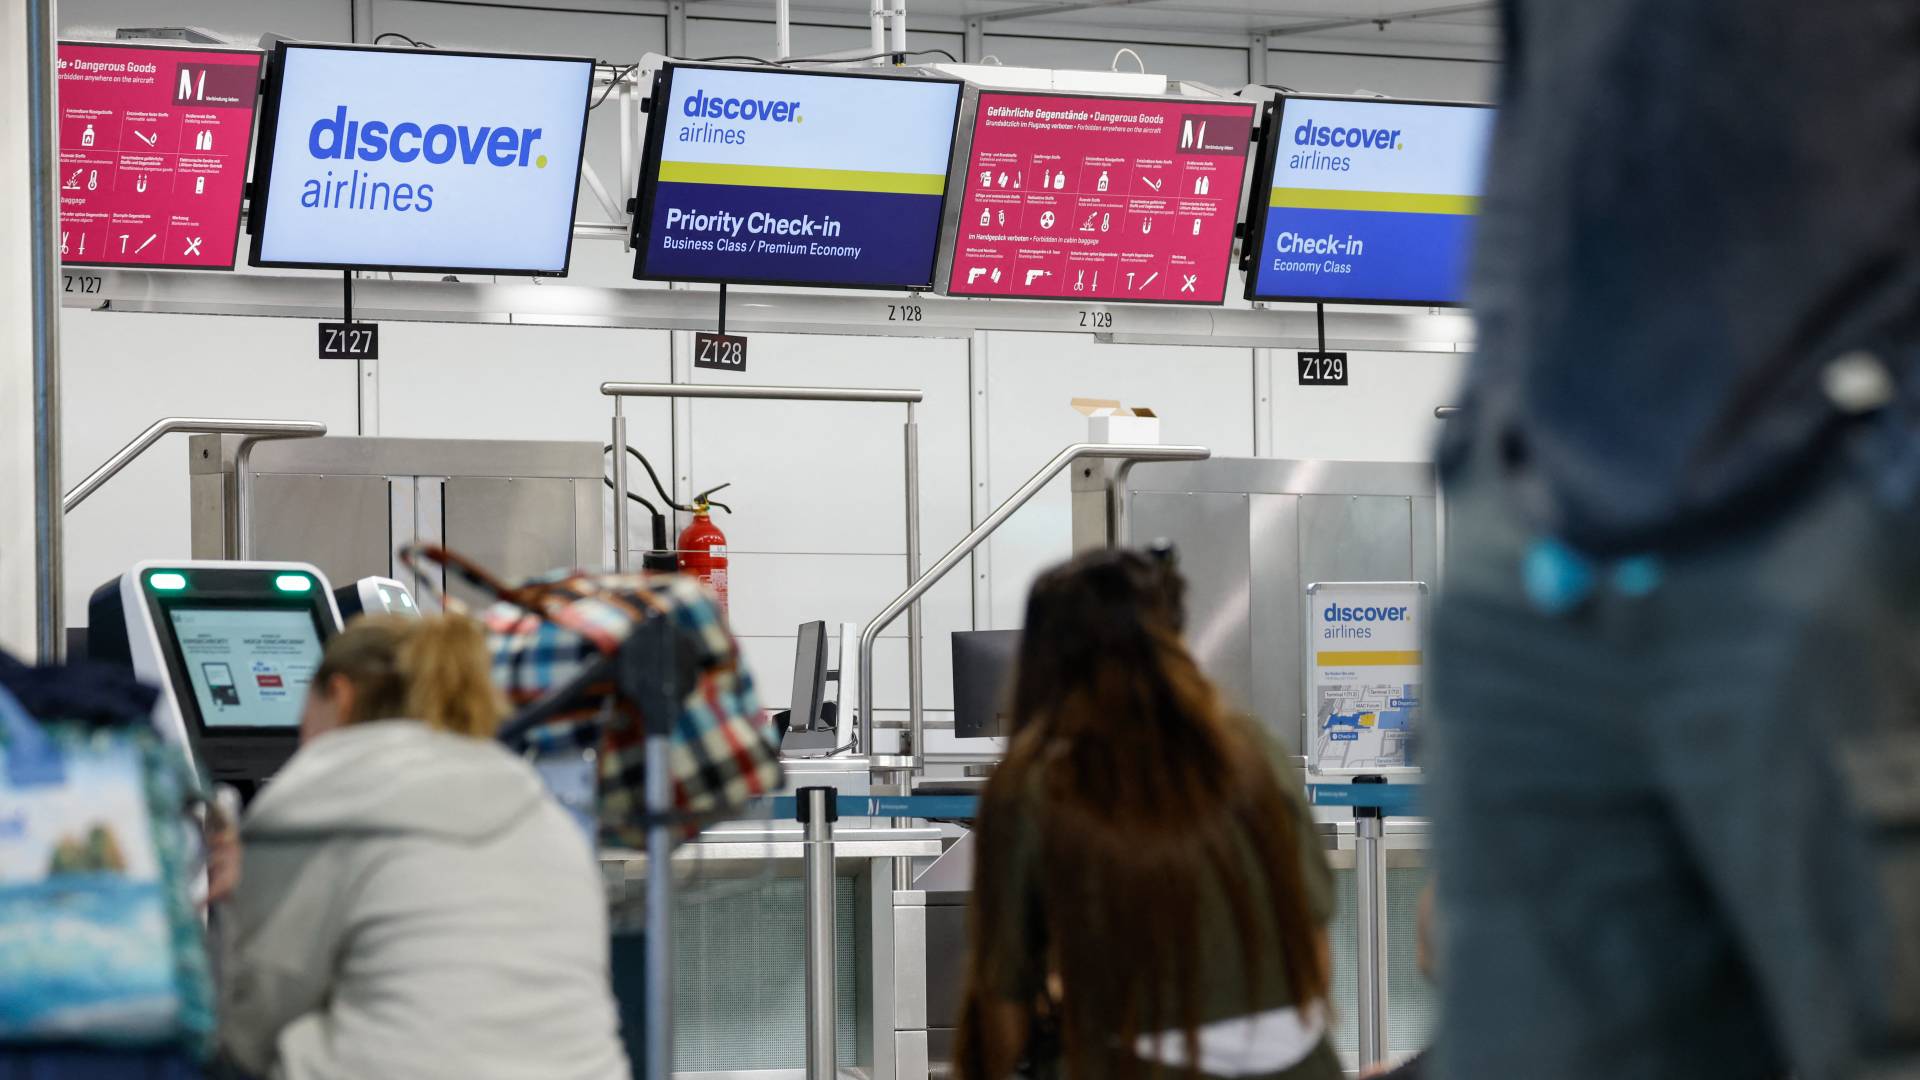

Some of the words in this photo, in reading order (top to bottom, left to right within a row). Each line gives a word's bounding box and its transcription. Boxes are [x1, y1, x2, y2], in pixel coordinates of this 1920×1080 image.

[74, 59, 125, 73] Dangerous
[127, 61, 157, 73] Goods
[985, 119, 1020, 128] Grundsätzlich
[1028, 121, 1051, 130] Flugzeug
[987, 106, 1034, 118] Gefährliche
[1035, 108, 1088, 121] Gegenstände
[1094, 112, 1137, 124] Dangerous
[1139, 113, 1164, 124] Goods
[679, 121, 746, 145] airlines
[1290, 149, 1351, 172] airlines
[301, 169, 434, 212] airlines
[666, 208, 744, 237] Priority
[747, 211, 841, 237] Check-in
[663, 236, 714, 251] Business
[716, 238, 747, 252] Class
[749, 240, 756, 252] /
[757, 240, 807, 254] Premium
[810, 243, 861, 259] Economy
[976, 233, 1006, 242] Handgepäck
[1276, 231, 1364, 256] Check-in
[1273, 258, 1321, 275] Economy
[1323, 260, 1352, 274] Class
[64, 275, 74, 293] Z
[78, 276, 102, 294] 127
[888, 305, 896, 321] Z
[900, 305, 923, 322] 128
[1079, 312, 1087, 327] Z
[1091, 312, 1113, 328] 129
[325, 329, 373, 353] Z127
[700, 338, 742, 365] Z128
[1303, 357, 1343, 380] Z129
[1324, 623, 1372, 639] airlines
